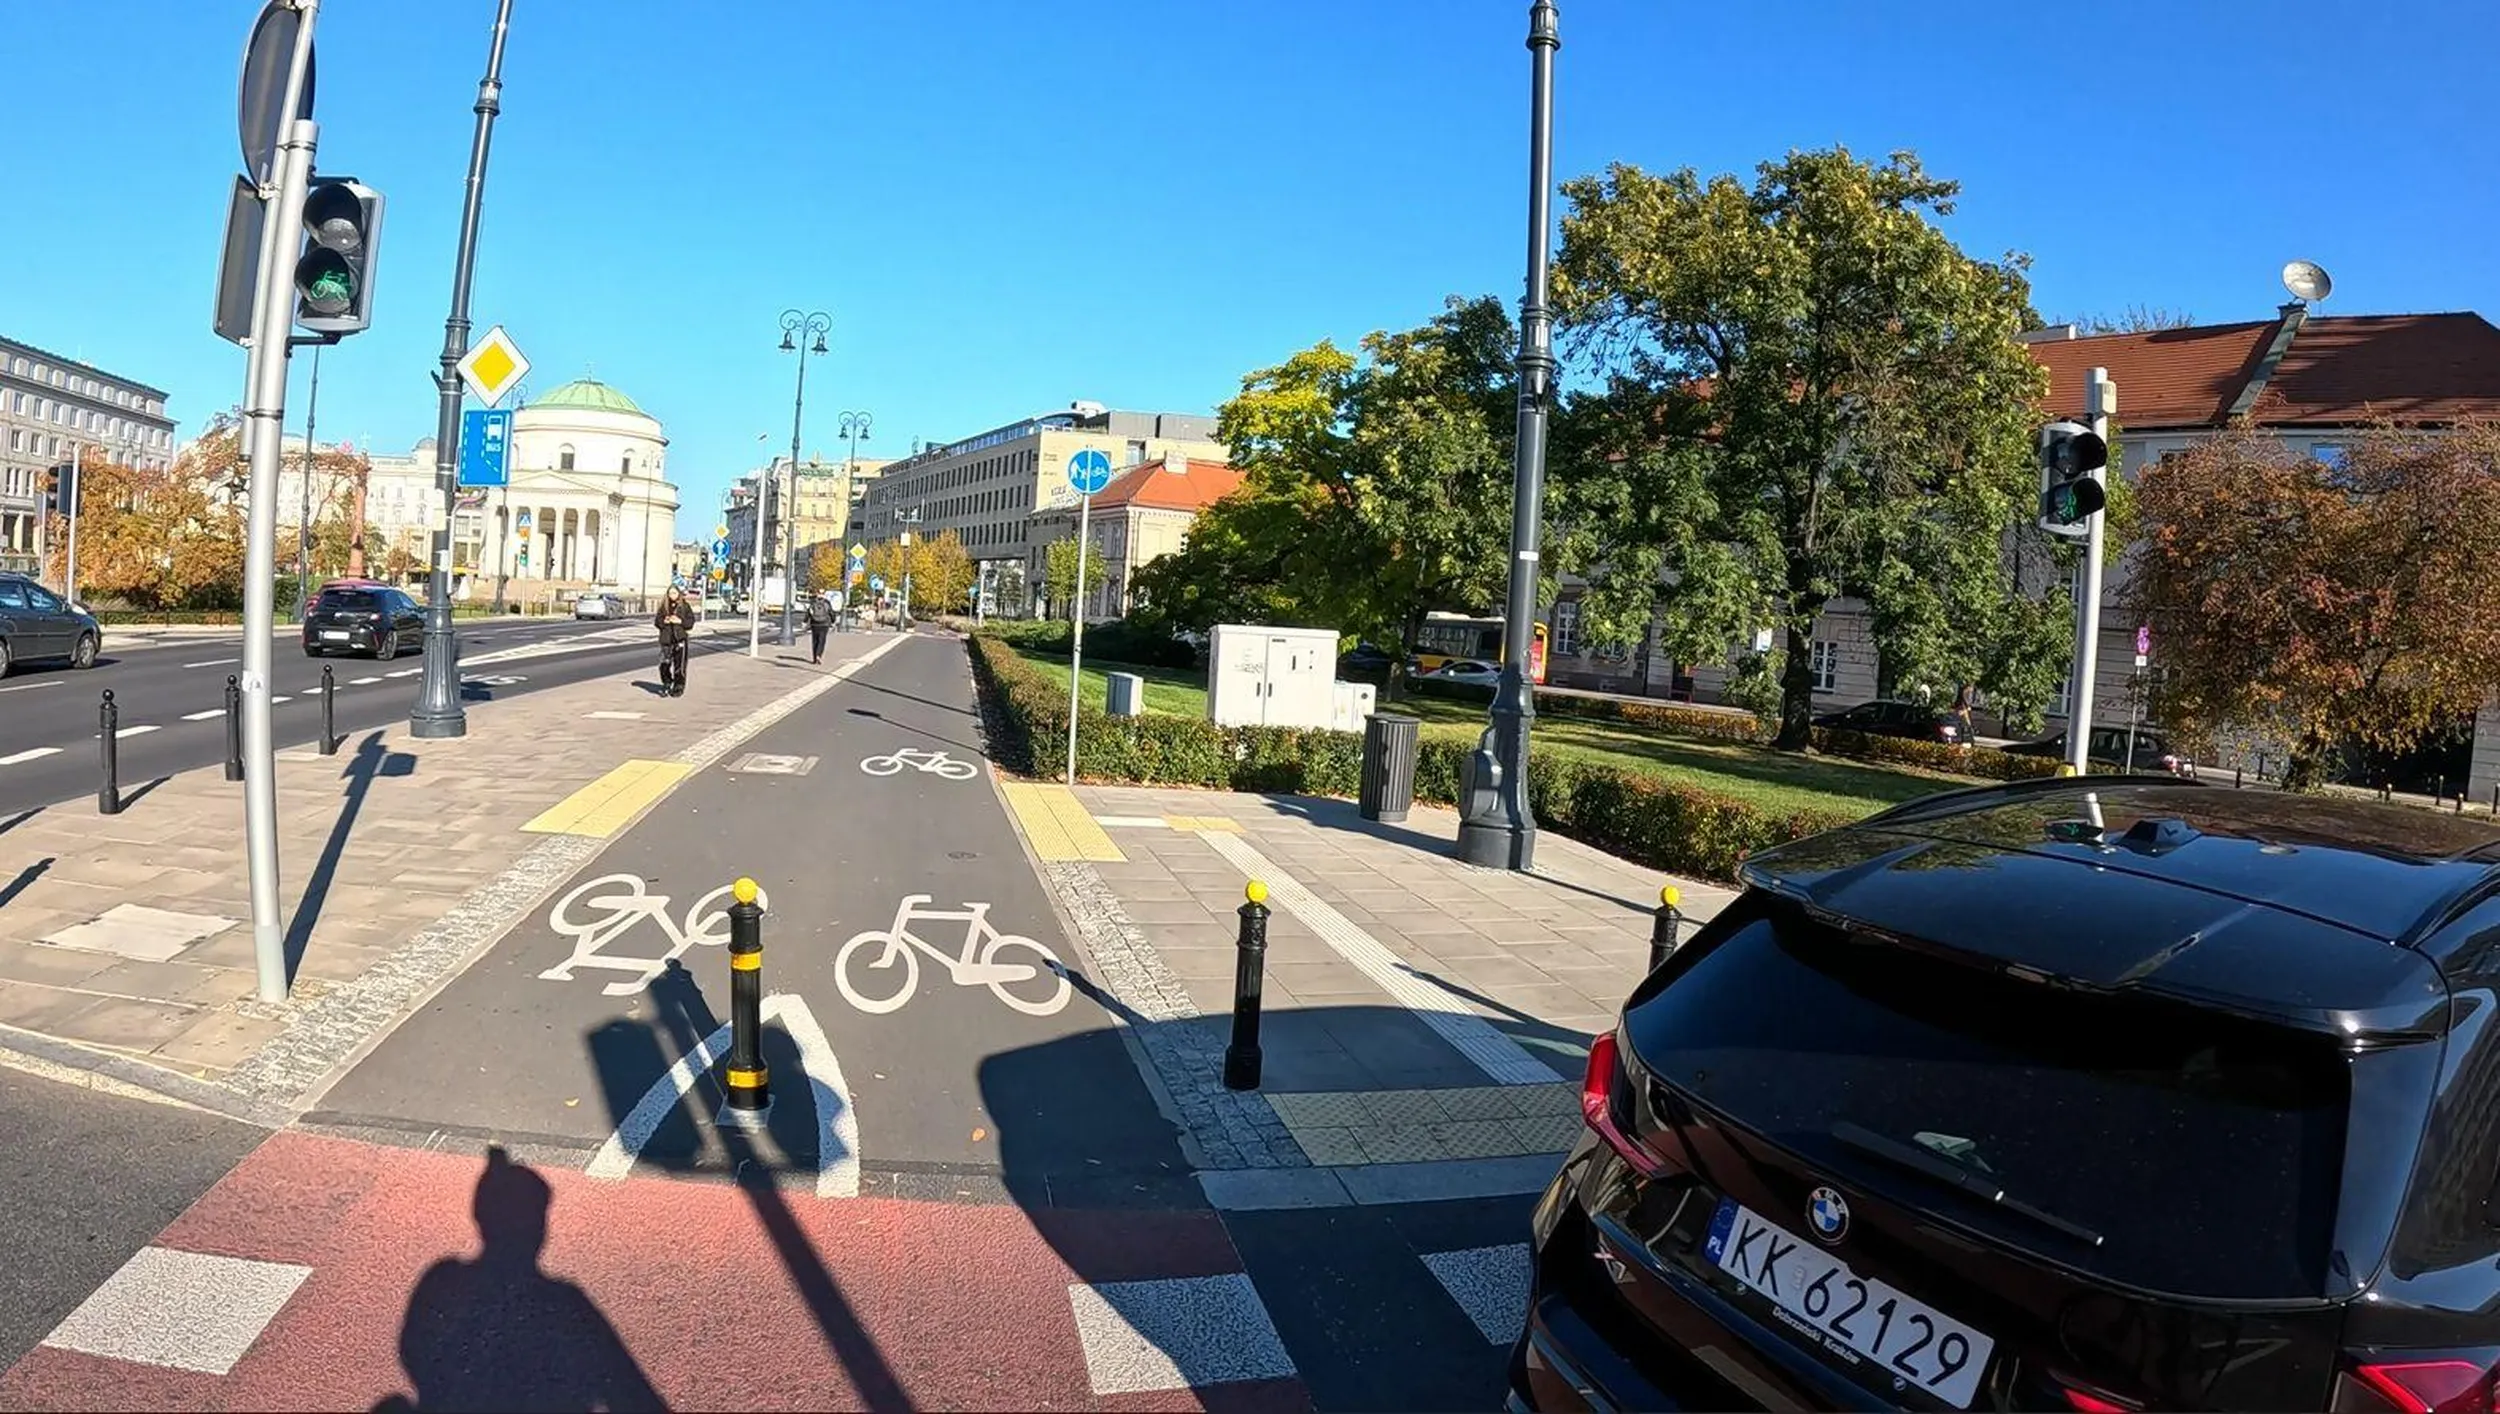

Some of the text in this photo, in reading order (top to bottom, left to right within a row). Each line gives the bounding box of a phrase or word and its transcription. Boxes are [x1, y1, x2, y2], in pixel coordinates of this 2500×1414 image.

[485, 443, 502, 452] BUS
[1707, 1235, 1722, 1255] PL
[1730, 1218, 1970, 1386] KK 62129
